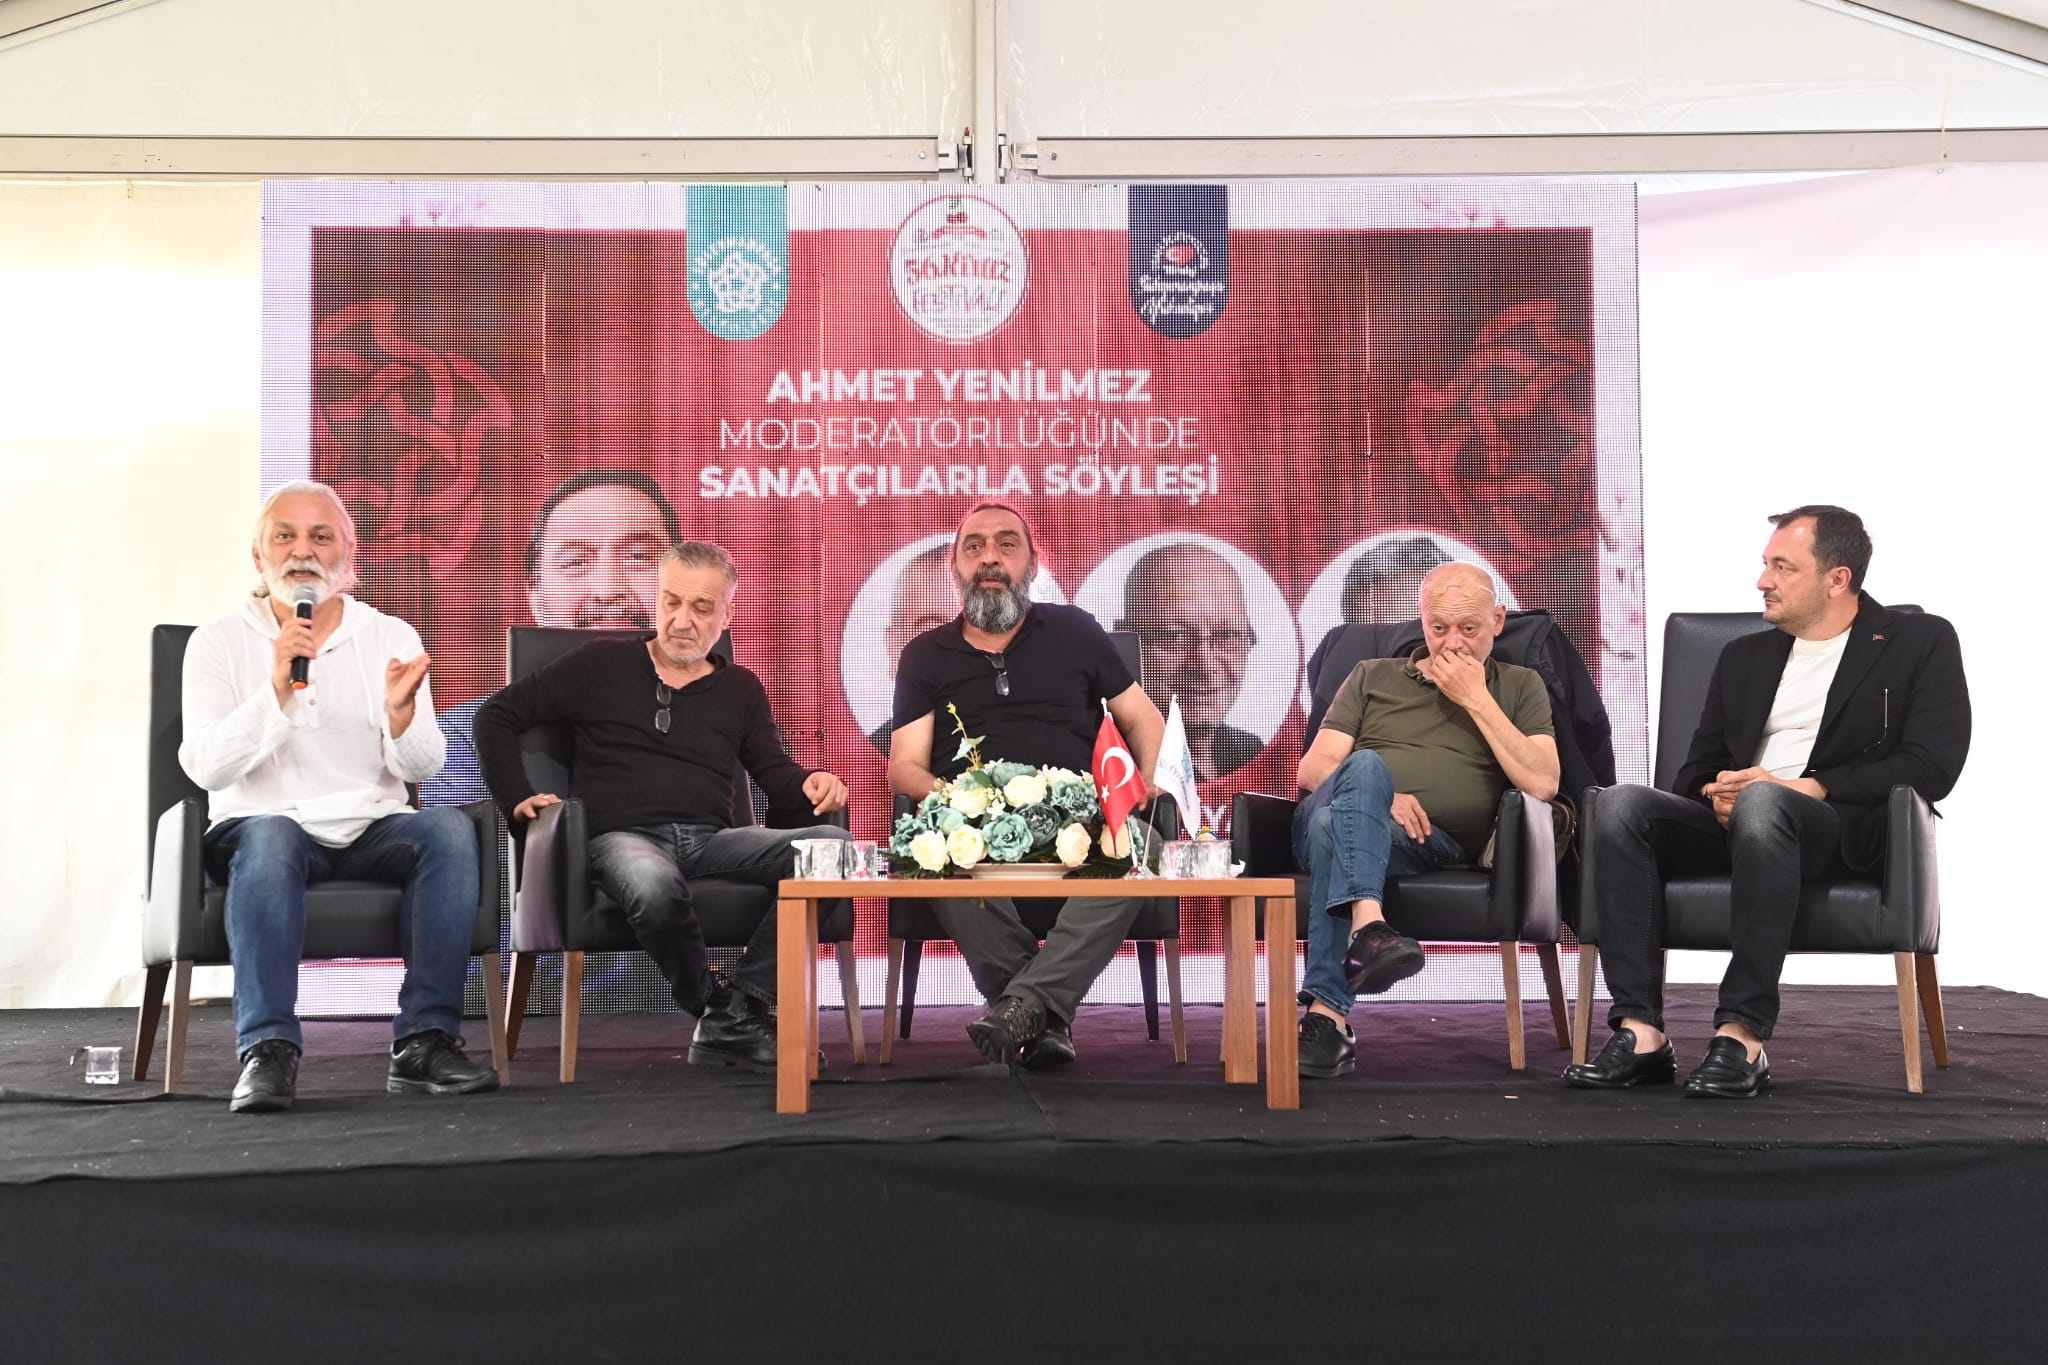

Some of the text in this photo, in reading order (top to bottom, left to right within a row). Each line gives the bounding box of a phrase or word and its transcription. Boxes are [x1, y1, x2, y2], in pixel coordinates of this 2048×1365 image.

[767, 359, 1151, 402] AHMET YENİLMEZ
[720, 409, 1199, 451] MODERATÖRLÜĞÜNDE
[699, 454, 1219, 507] SANATÇILARLA SÖYLEŞİ
